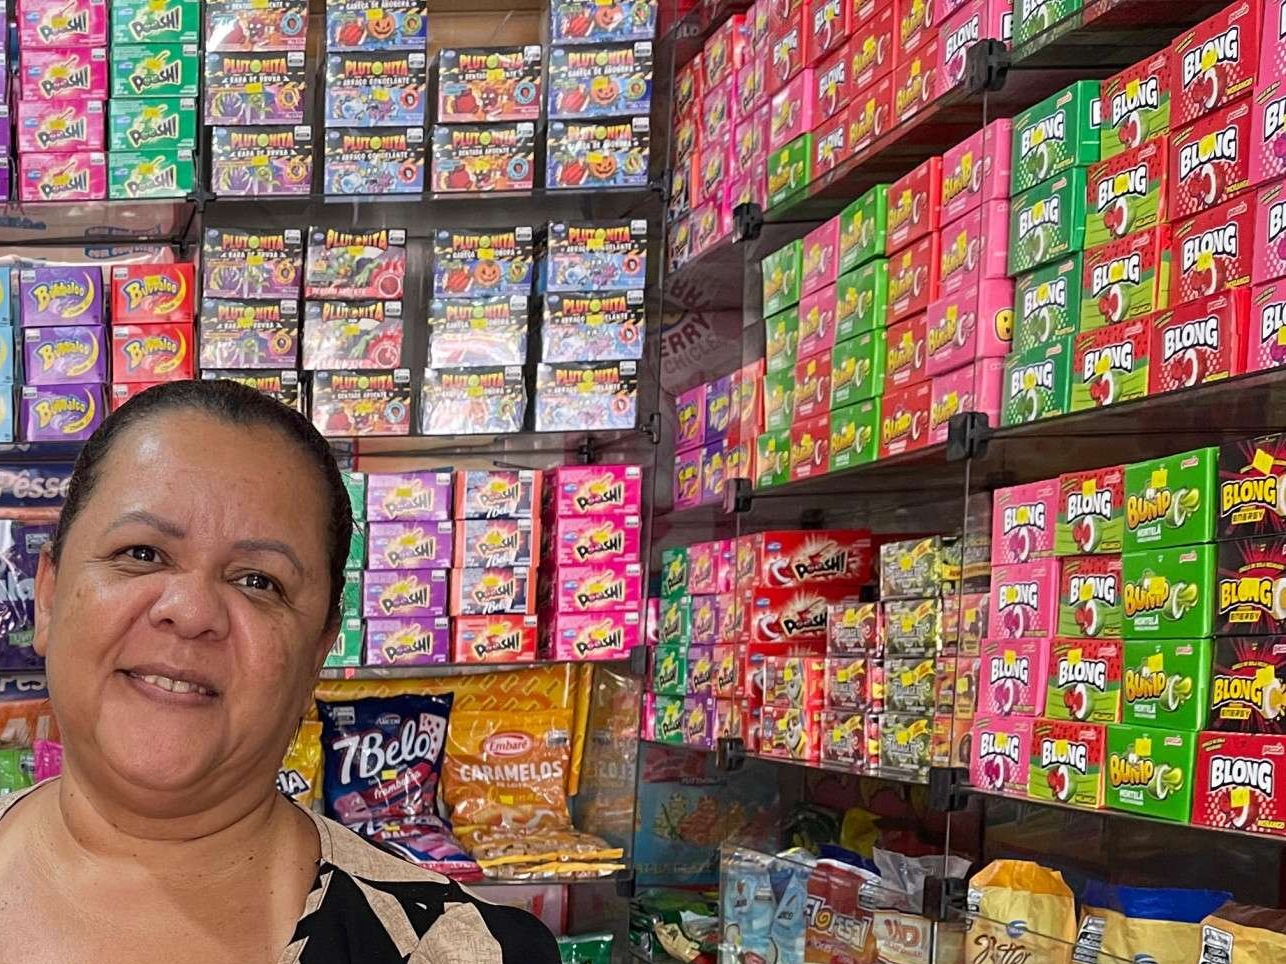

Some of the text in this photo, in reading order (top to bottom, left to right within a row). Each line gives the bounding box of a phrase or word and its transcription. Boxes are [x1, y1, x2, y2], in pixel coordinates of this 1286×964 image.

[944, 14, 980, 63] BLONG
[1182, 222, 1239, 274] BLONG
[1163, 315, 1219, 364] BLONG
[1066, 490, 1113, 521] BLONG
[1126, 488, 1172, 530] BUMP
[1220, 475, 1278, 519] BLONG
[1230, 509, 1265, 526] ENERGY
[1057, 656, 1107, 692] BLONG
[1122, 666, 1167, 703] BUMP
[1212, 676, 1265, 709] BLONG
[332, 720, 432, 785] 7Belo
[488, 735, 529, 753] Embaré
[459, 759, 563, 782] CARAMELOS
[1108, 754, 1155, 789] BUMP
[1209, 755, 1274, 799] BLONG
